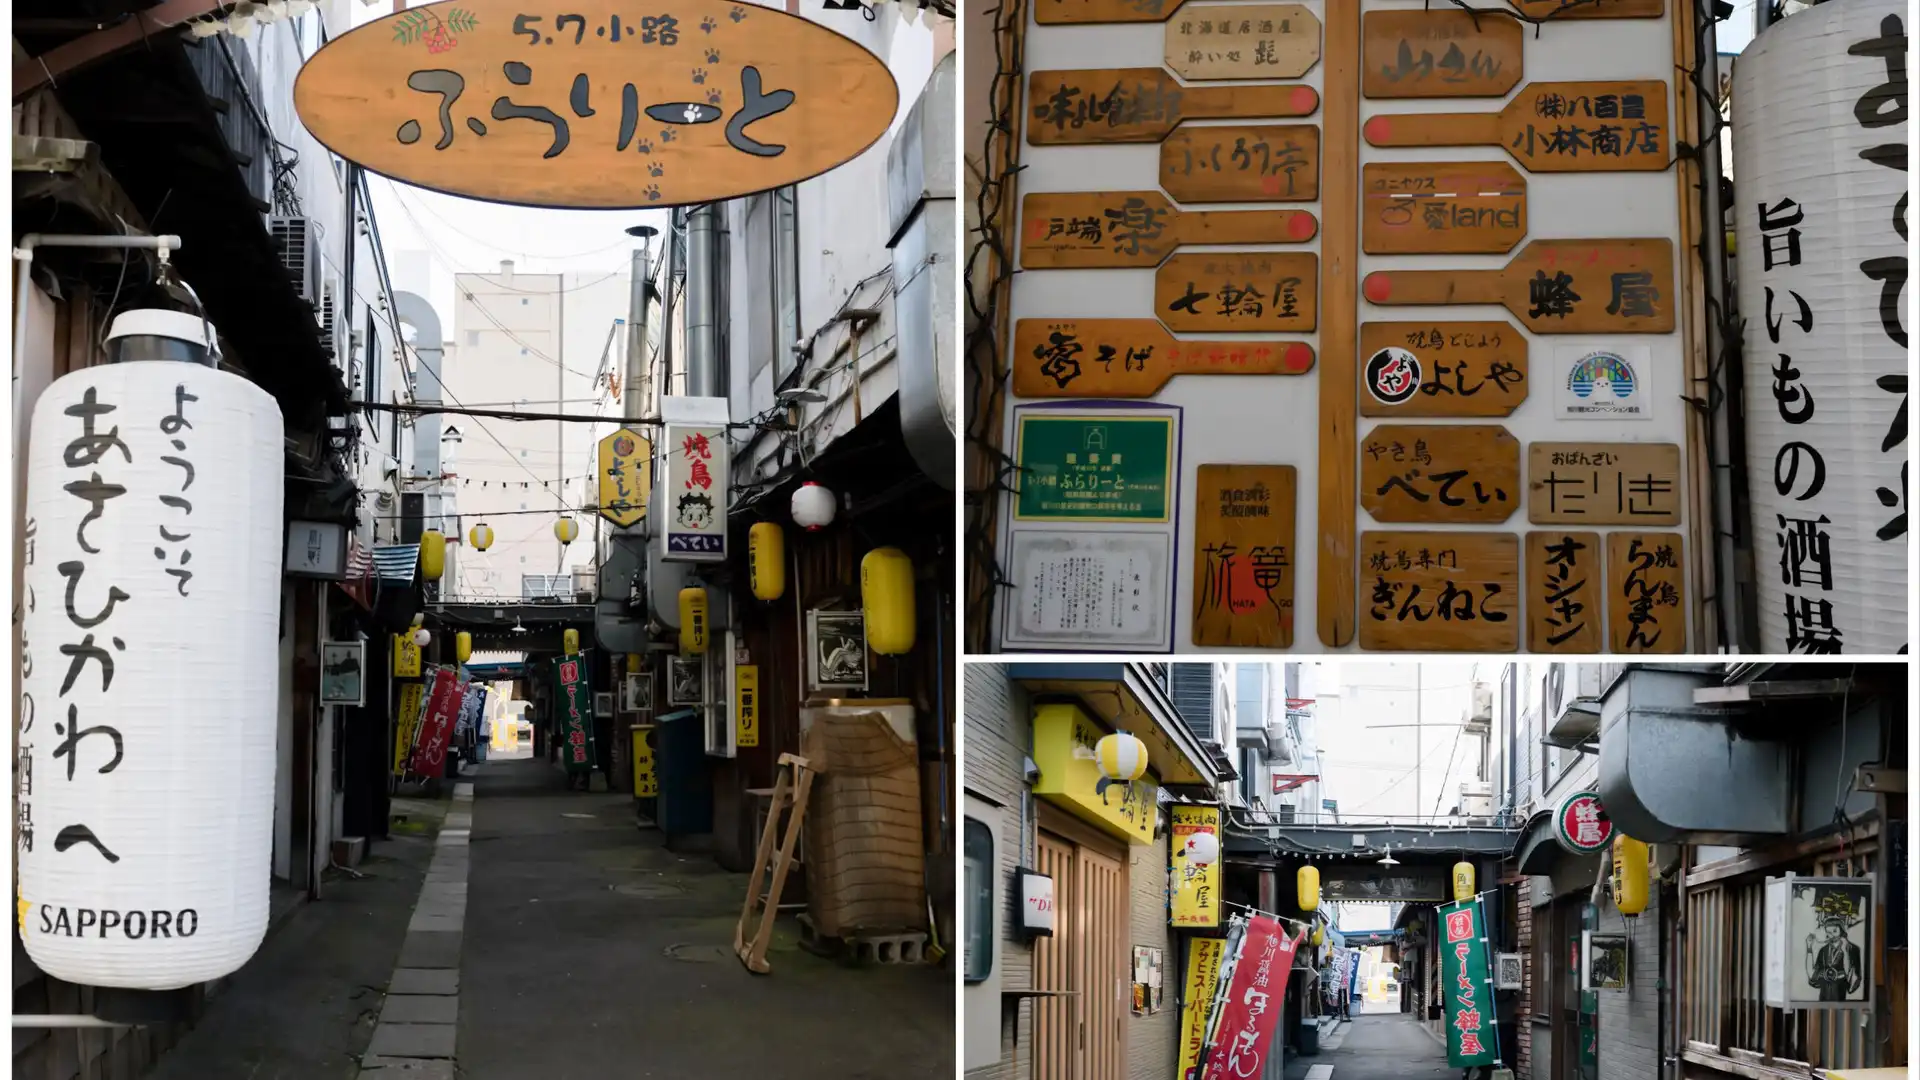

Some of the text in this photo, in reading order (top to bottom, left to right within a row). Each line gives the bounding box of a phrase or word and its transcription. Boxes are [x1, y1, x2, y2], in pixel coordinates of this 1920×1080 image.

[1180, 20, 1292, 34] 北海道居酒屋
[396, 66, 796, 159] ふらりーと
[1512, 122, 1660, 158] 小林商店
[1169, 137, 1308, 196] ふくろう亭
[1169, 277, 1303, 319] 七輪屋
[1528, 270, 1660, 320] 蜂屋
[1421, 360, 1524, 396] よしや
[1758, 197, 1844, 654] 旨いもの酒場
[682, 432, 713, 490] 焼鳥
[1367, 438, 1432, 466] やき鳥
[1551, 452, 1618, 466] おばんざい
[154, 385, 199, 597] ようこそ
[607, 457, 632, 517] よしや
[1060, 474, 1125, 490] ふらりーと
[1543, 471, 1672, 515] たりき
[1370, 548, 1457, 570] 焼鳥専門
[1656, 545, 1680, 607] 焼鳥
[1232, 599, 1294, 608] HATA GO
[1370, 577, 1508, 622] ぎんねこ
[1544, 536, 1586, 646] オーシャン
[1623, 540, 1662, 648] らんまん
[53, 386, 132, 864] あさひかわへ
[1575, 802, 1603, 843] 蜂屋
[40, 904, 199, 940] SAPPORO
[1253, 934, 1278, 988] 旭川醤油
[1188, 941, 1211, 1065] アサヒスーパードライ
[1453, 942, 1486, 1057] ラーメン蜂屋
